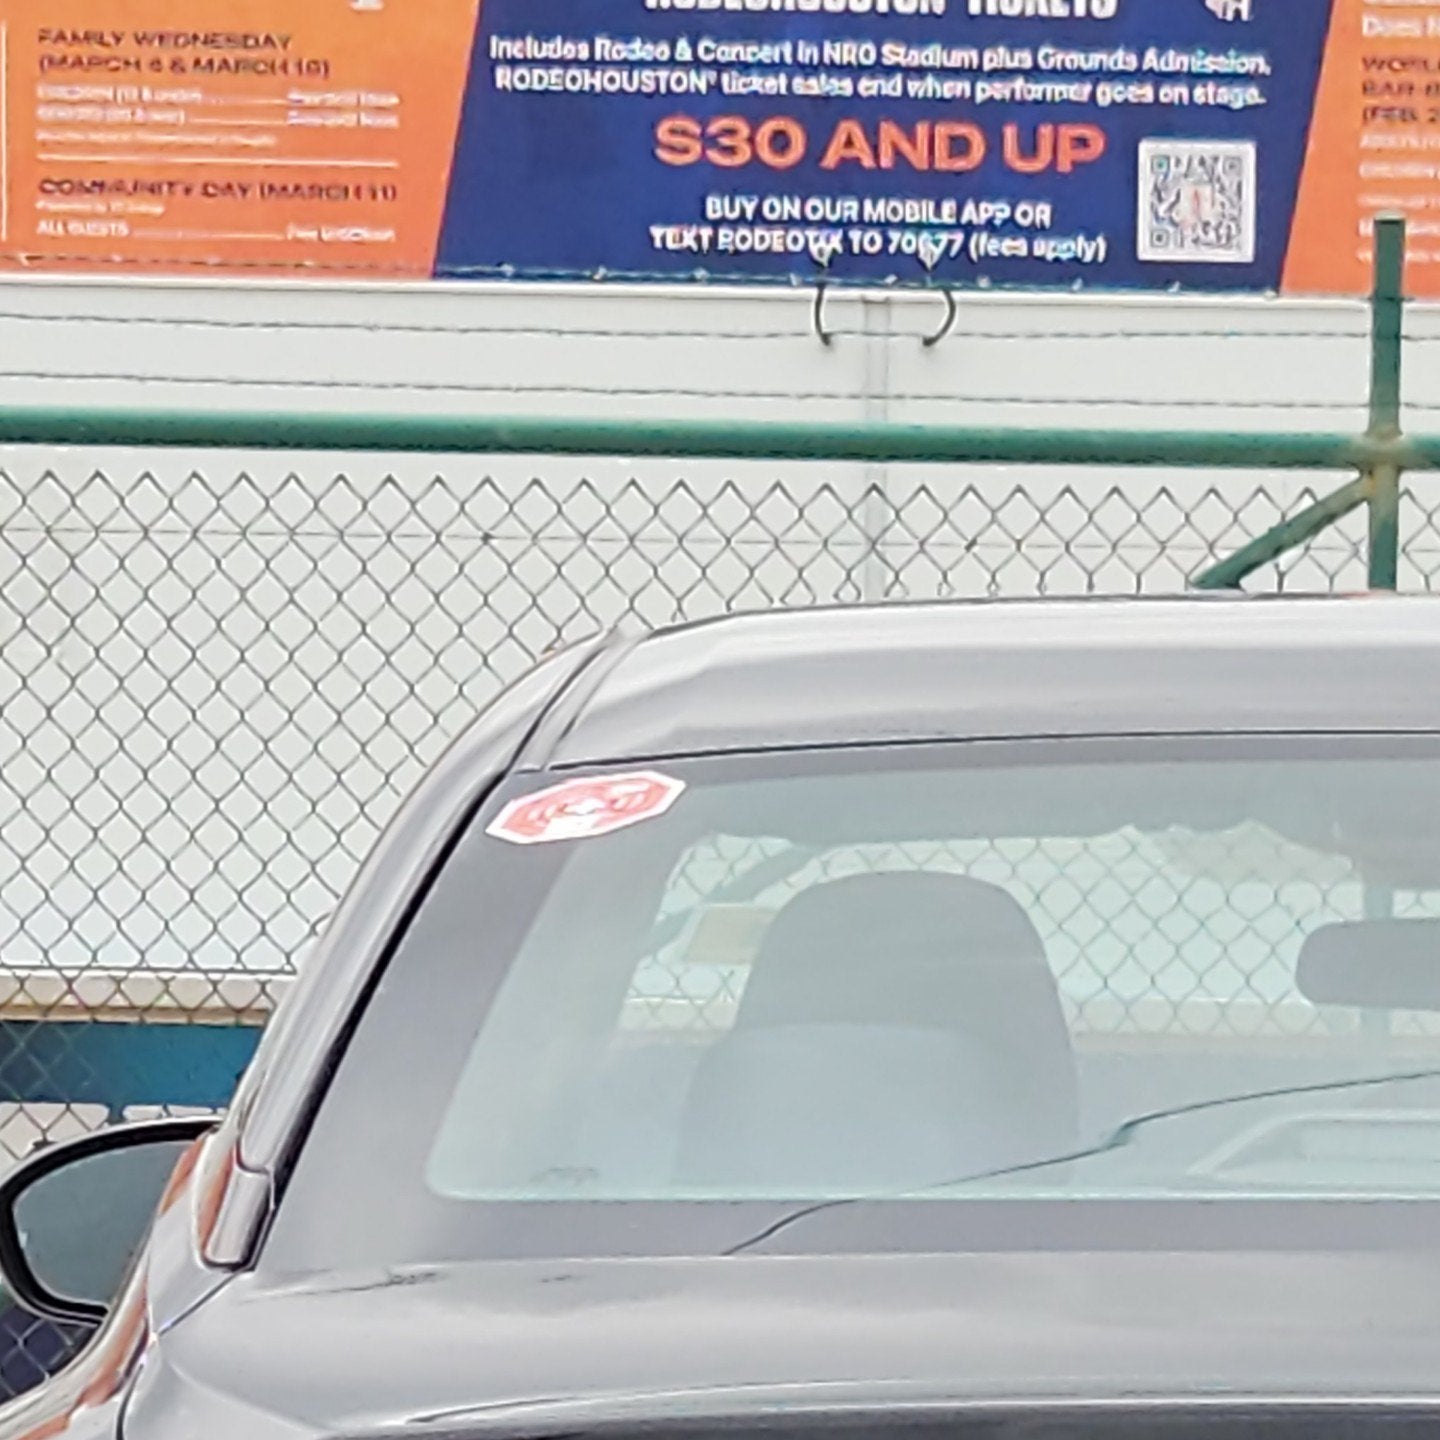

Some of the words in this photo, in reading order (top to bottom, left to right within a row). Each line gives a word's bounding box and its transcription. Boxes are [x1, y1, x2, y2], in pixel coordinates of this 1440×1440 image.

[489, 34, 589, 62] Includes
[594, 35, 670, 63] Rodeo
[696, 37, 793, 65] Concert
[881, 43, 978, 71] Stadium
[982, 45, 1033, 74] plus
[1036, 46, 1138, 73] Grounds
[906, 75, 971, 101] when
[1159, 83, 1189, 105] on
[818, 117, 989, 173] AND
[1001, 121, 1108, 174] UP
[705, 194, 757, 222] BUY
[761, 197, 802, 222] ON
[805, 197, 859, 223] OUR
[862, 198, 958, 225] MOBILE
[960, 199, 1012, 227] APP
[1015, 200, 1052, 228] OR
[649, 225, 711, 250] TEXT
[847, 228, 882, 255] TO
